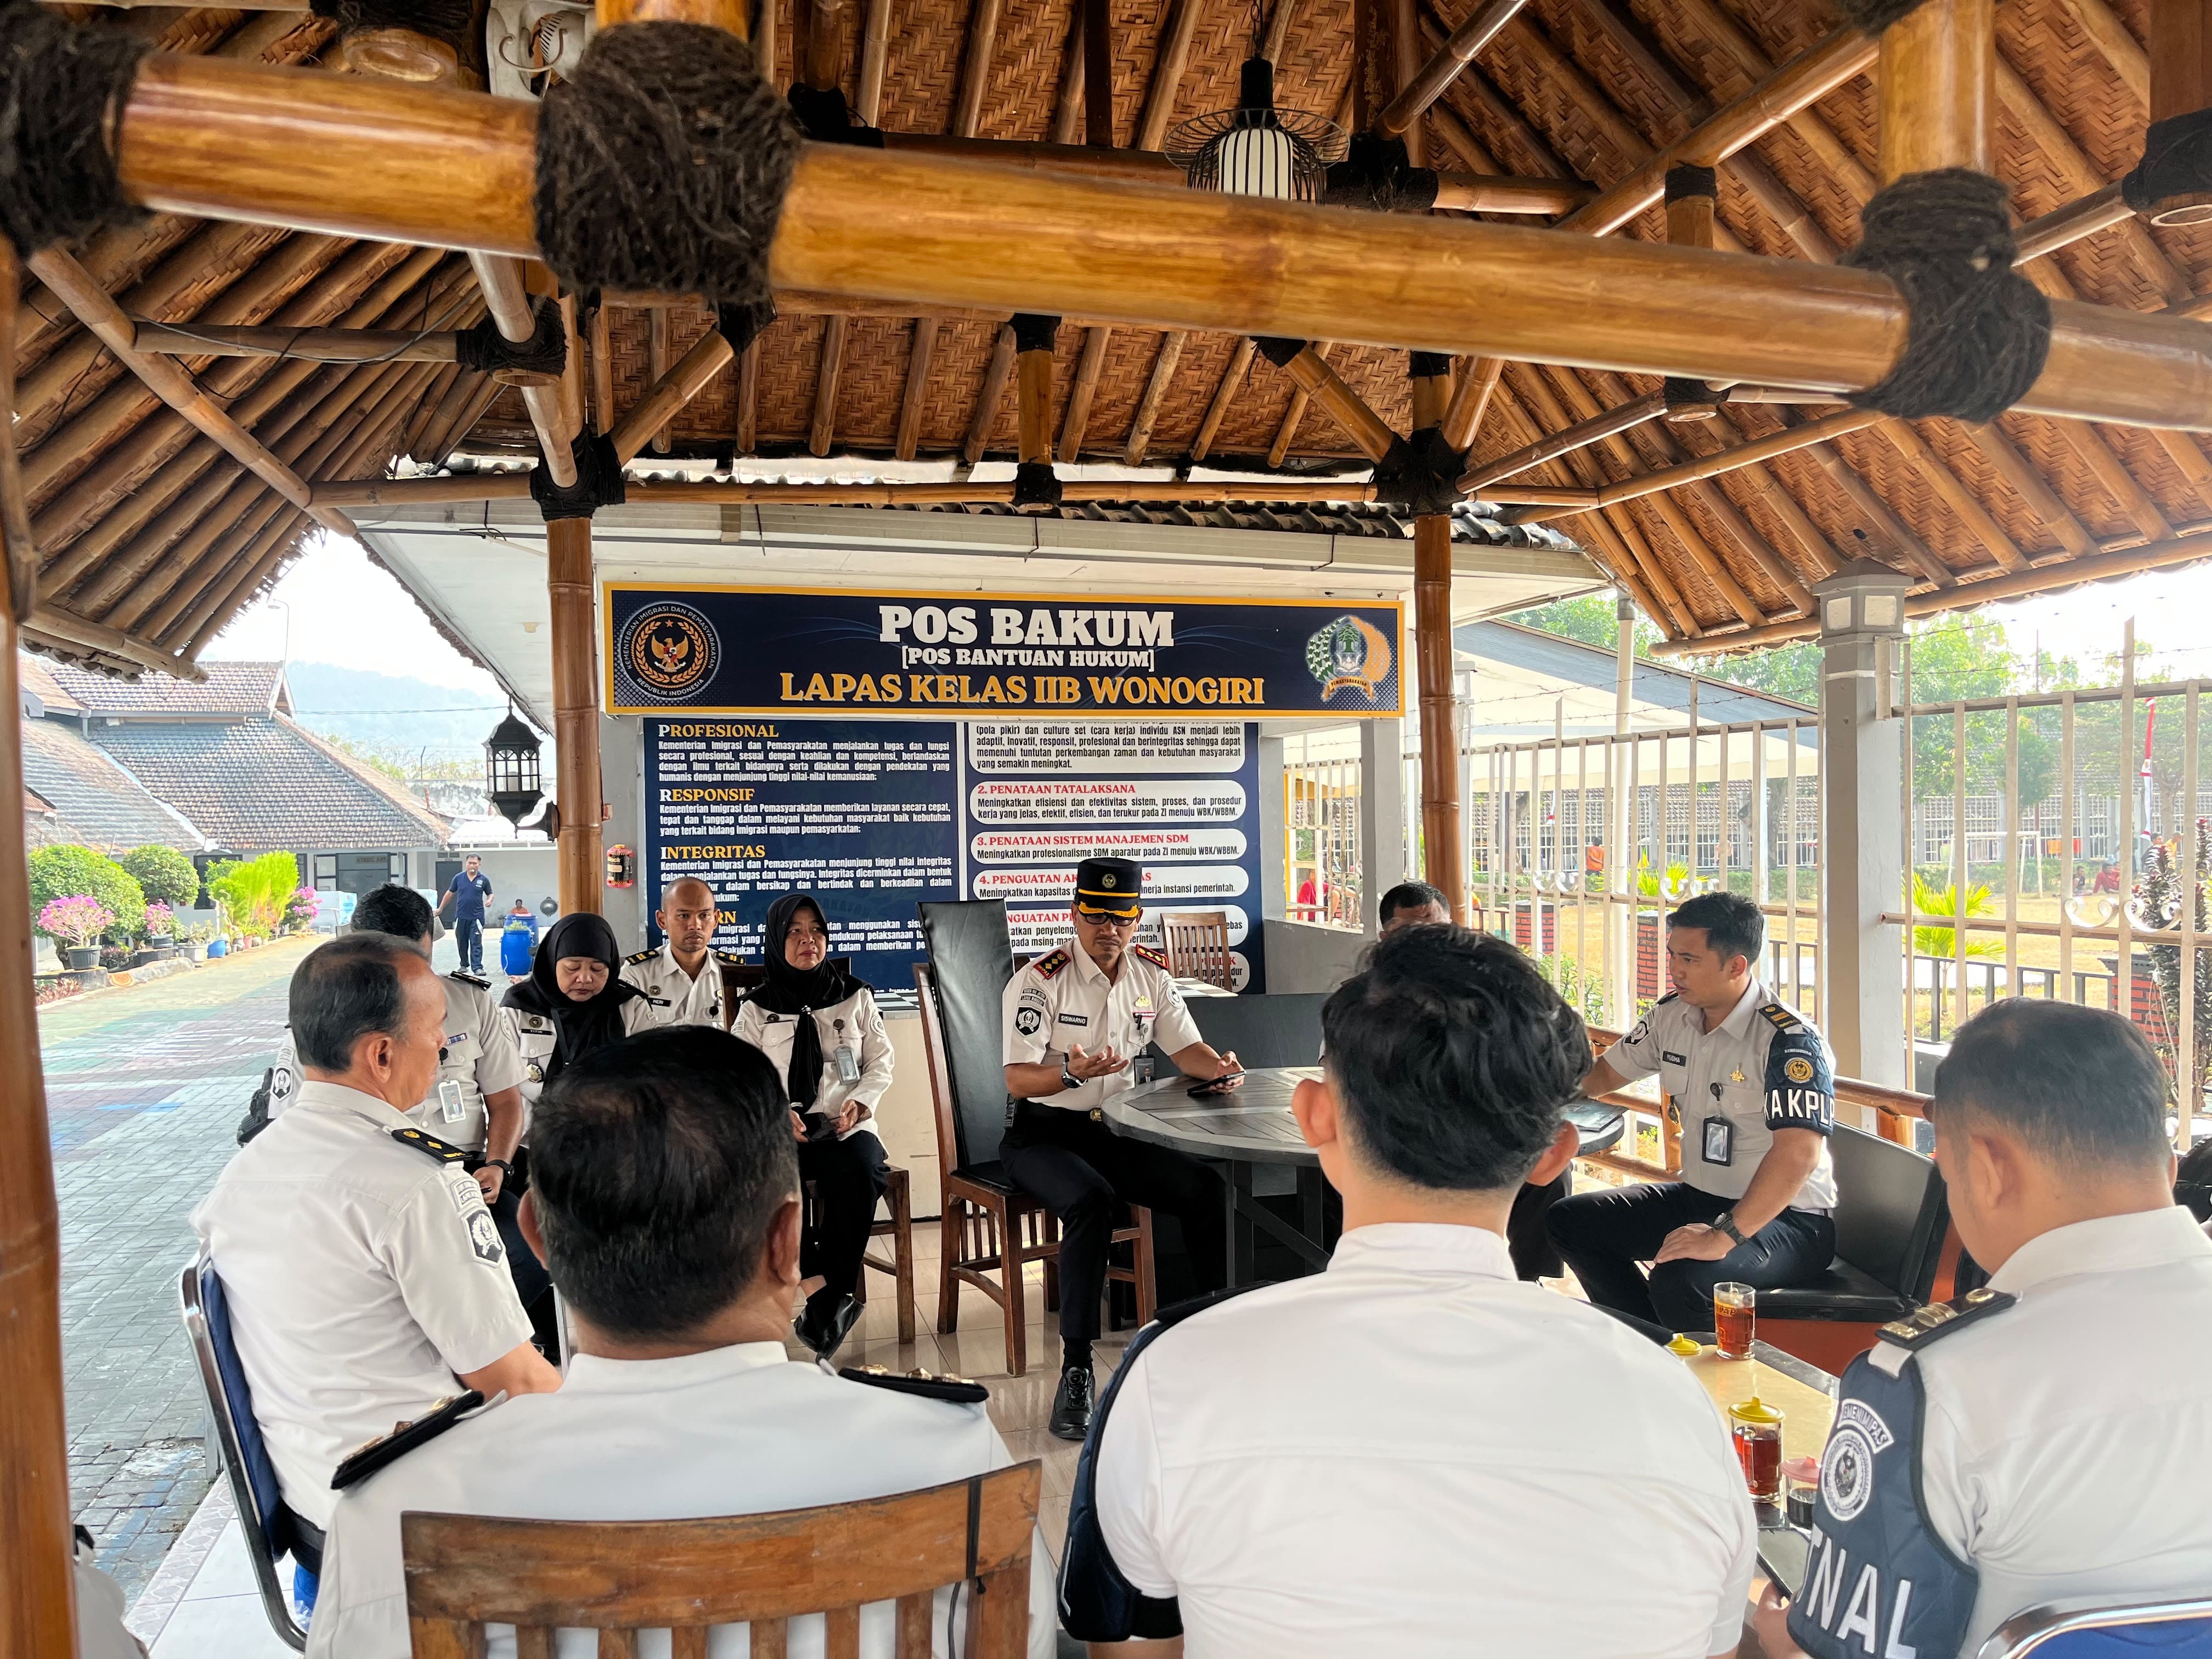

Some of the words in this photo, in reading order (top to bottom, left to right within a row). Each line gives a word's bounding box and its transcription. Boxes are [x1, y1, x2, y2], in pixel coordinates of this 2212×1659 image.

[879, 605, 978, 644] POS
[990, 608, 1174, 646] BAKUM
[622, 619, 640, 670] KEMENTERIAN
[638, 606, 669, 622] IMIGRASI
[670, 606, 687, 615] DAN
[687, 611, 716, 669] PEMASYARAKATAN
[956, 648, 1064, 667] BANTUAN
[636, 677, 668, 696] REPUBLIK
[669, 679, 704, 696] INDONESIA
[780, 672, 904, 703] LAPAS
[909, 674, 1028, 703] KELAS
[1033, 676, 1081, 704] IIB
[1086, 675, 1265, 704] WONOGIRI
[658, 724, 779, 737] PROFESIONAL
[976, 725, 995, 735] (pola
[1000, 725, 1020, 736] pikir)
[1025, 725, 1039, 735] dan
[1043, 726, 1069, 735] culture
[1074, 726, 1086, 735] set
[1091, 726, 1109, 735] (cara
[1114, 725, 1135, 735] kerja)
[1140, 725, 1168, 735] individu
[1172, 726, 1186, 735] ASN
[1190, 726, 1218, 735] menjadi
[1223, 725, 1240, 735] lebih
[658, 741, 706, 750] Kementerian
[711, 741, 742, 751] Imigrasi
[747, 741, 761, 750] dan
[766, 741, 828, 751] Pemasyarakatan
[832, 741, 879, 751] menjalankan
[884, 741, 904, 751] tugas
[909, 741, 923, 751] dan
[927, 741, 949, 751] fungsi
[1079, 737, 1120, 747] profesional
[1122, 737, 1136, 746] dan
[1138, 736, 1184, 747] berintegritas
[1186, 737, 1218, 747] sehingga
[1221, 737, 1240, 747] dapat
[658, 752, 685, 760] secara
[738, 751, 764, 760] sesuai
[768, 751, 796, 761] dengan
[800, 751, 831, 760] keahlian
[836, 752, 849, 760] dan
[901, 752, 950, 760] berlandaskan
[977, 748, 1016, 757] memenuhi
[1020, 748, 1052, 757] tuntutan
[1055, 748, 1110, 758] perkembangan
[1113, 749, 1137, 757] zaman
[1141, 748, 1154, 757] dan
[1158, 748, 1195, 757] kebutuhan
[1199, 748, 1240, 757] masyarakat
[977, 760, 995, 769] yang
[997, 759, 1029, 768] semakin
[659, 772, 692, 781] humanis
[693, 772, 721, 782] dengan
[723, 771, 767, 782] menjunjung
[768, 771, 790, 782] tinggi
[659, 788, 755, 802] RESPONSIF
[990, 785, 1052, 794] PENATAAN
[1053, 785, 1136, 793] TATALAKSANA
[978, 798, 1031, 808] Meningkatkan
[1035, 797, 1066, 807] efisiensi
[1071, 798, 1085, 806] dan
[1089, 797, 1127, 806] efektivitas
[1193, 797, 1206, 805] dan
[1210, 797, 1242, 806] prosedur
[659, 804, 709, 814] Kementerian
[710, 803, 742, 814] Imigrasi
[743, 803, 758, 812] dan
[759, 803, 822, 813] Pemasyarakatan
[823, 803, 870, 812] memberikan
[871, 803, 900, 812] layanan
[901, 803, 927, 811] secara
[978, 809, 997, 819] kerja
[999, 810, 1018, 820] yang
[1098, 808, 1111, 817] dan
[1113, 808, 1139, 817] terukur
[1141, 808, 1159, 818] pada
[1169, 807, 1195, 817] menuju
[659, 827, 680, 837] yang
[680, 825, 707, 835] terkait
[708, 825, 735, 836] bidang
[736, 825, 768, 835] imigrasi
[769, 826, 800, 835] maupun
[989, 836, 1051, 845] PENATAAN
[1053, 836, 1093, 845] SISTEM
[1095, 834, 1164, 844] MANAJEMEN
[1166, 834, 1188, 843] SDM
[660, 845, 765, 859] INTEGRITAS
[977, 849, 1030, 859] Meningkatkan
[1032, 848, 1091, 859] profesionalisme
[1093, 848, 1109, 857] SDM
[1110, 848, 1141, 857] aparatur
[1143, 847, 1160, 857] pada
[1170, 847, 1197, 856] menuju
[660, 860, 710, 871] Kementerian
[712, 860, 744, 870] Imigrasi
[746, 860, 761, 869] dan
[764, 859, 826, 869] Pemasyarakatan
[828, 857, 872, 867] menjunjung
[874, 857, 896, 867] tinggi
[898, 856, 915, 866] nilai
[917, 856, 952, 866] integritas
[738, 871, 760, 881] tugas
[761, 870, 776, 879] dan
[818, 868, 854, 879] Integritas
[855, 868, 901, 877] dicerminkan
[902, 867, 926, 877] dalam
[927, 867, 952, 876] bentuk
[992, 874, 1060, 884] PENGUATAN
[979, 888, 1032, 899] Meningkatkan
[1034, 887, 1070, 897] kapasitas
[1163, 884, 1192, 893] instansi
[1060, 1015, 1086, 1024] SISWARNO
